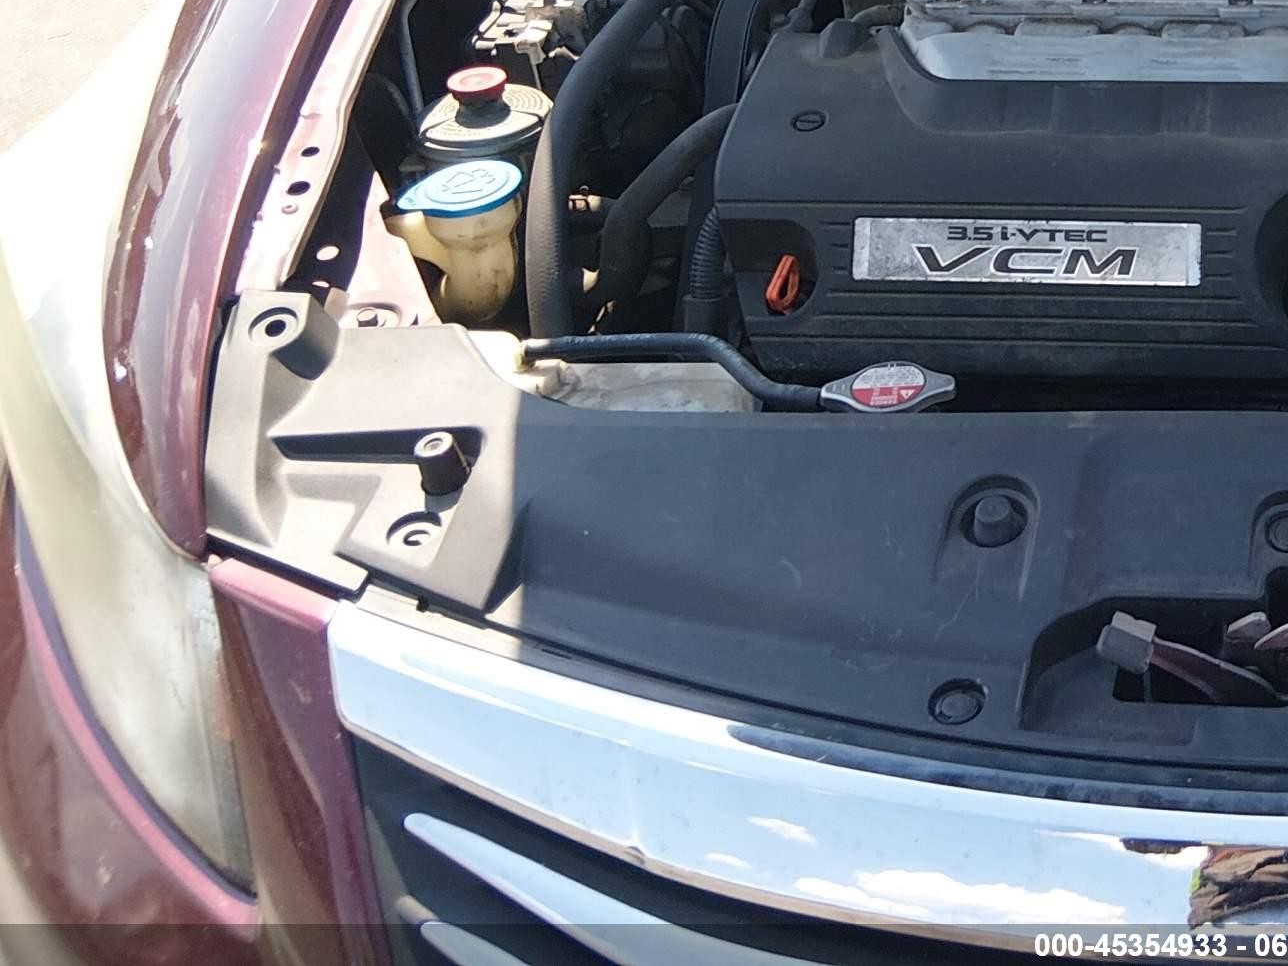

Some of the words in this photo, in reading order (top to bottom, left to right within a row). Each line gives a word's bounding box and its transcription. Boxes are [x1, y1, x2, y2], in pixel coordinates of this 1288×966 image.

[946, 225, 994, 242] 3.5
[1000, 226, 1108, 243] i-VTEC
[912, 244, 1139, 278] VCM
